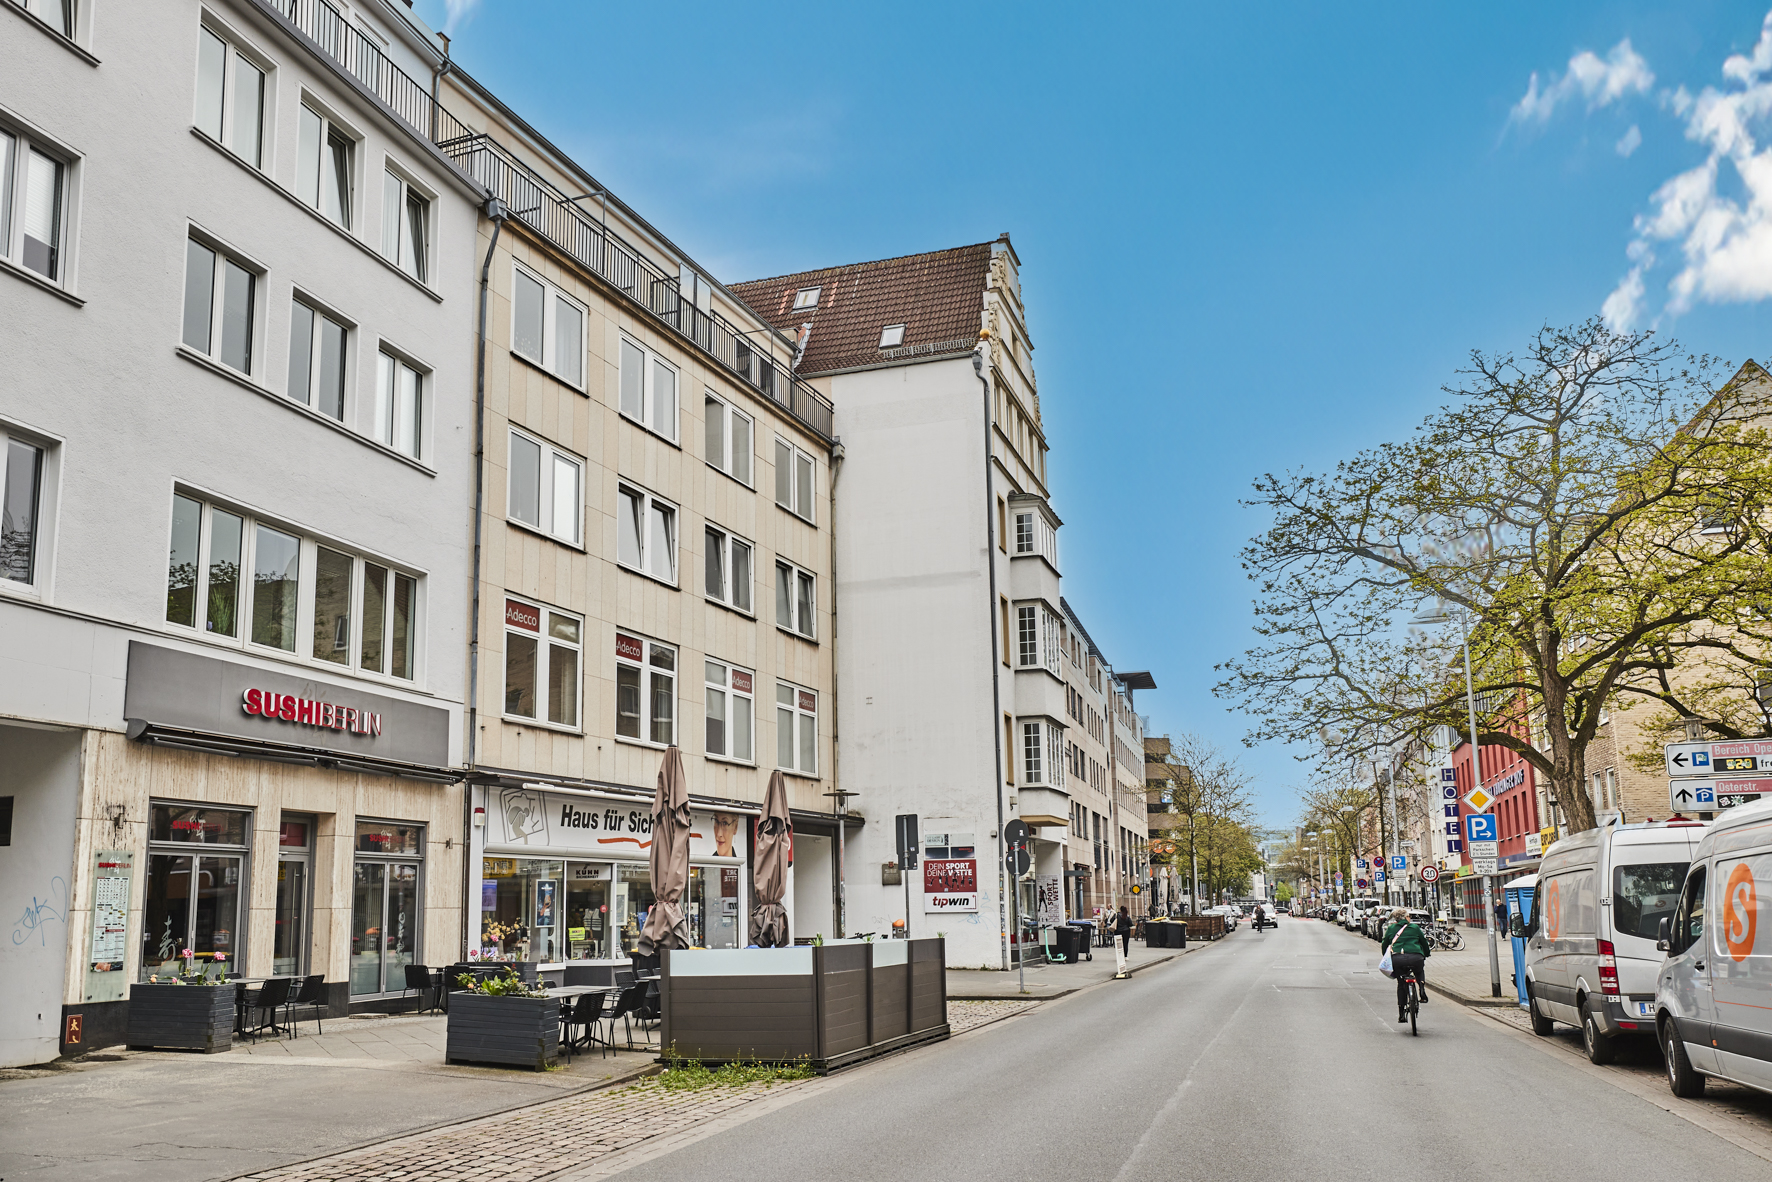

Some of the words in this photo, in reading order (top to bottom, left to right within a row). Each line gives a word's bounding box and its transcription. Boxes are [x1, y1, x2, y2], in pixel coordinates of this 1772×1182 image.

[506, 607, 537, 627] Adecco
[616, 640, 641, 657] Adecco
[732, 675, 751, 690] Adecco
[798, 696, 814, 709] Adecco
[242, 688, 382, 736] SUSHIBERLIN
[1714, 744, 1750, 755] Bereich
[1718, 782, 1759, 792] Osterstr.
[1700, 792, 1710, 802] P
[560, 804, 599, 830] Haus
[603, 808, 625, 831] für
[1443, 769, 1460, 852] HOTEL
[1471, 818, 1487, 838] P
[926, 869, 947, 877] DEINE
[947, 868, 973, 876] WETTE
[945, 862, 970, 870] SPORT
[1424, 870, 1436, 878] 30
[1046, 882, 1054, 906] SPORT
[932, 896, 970, 908] tipwin
